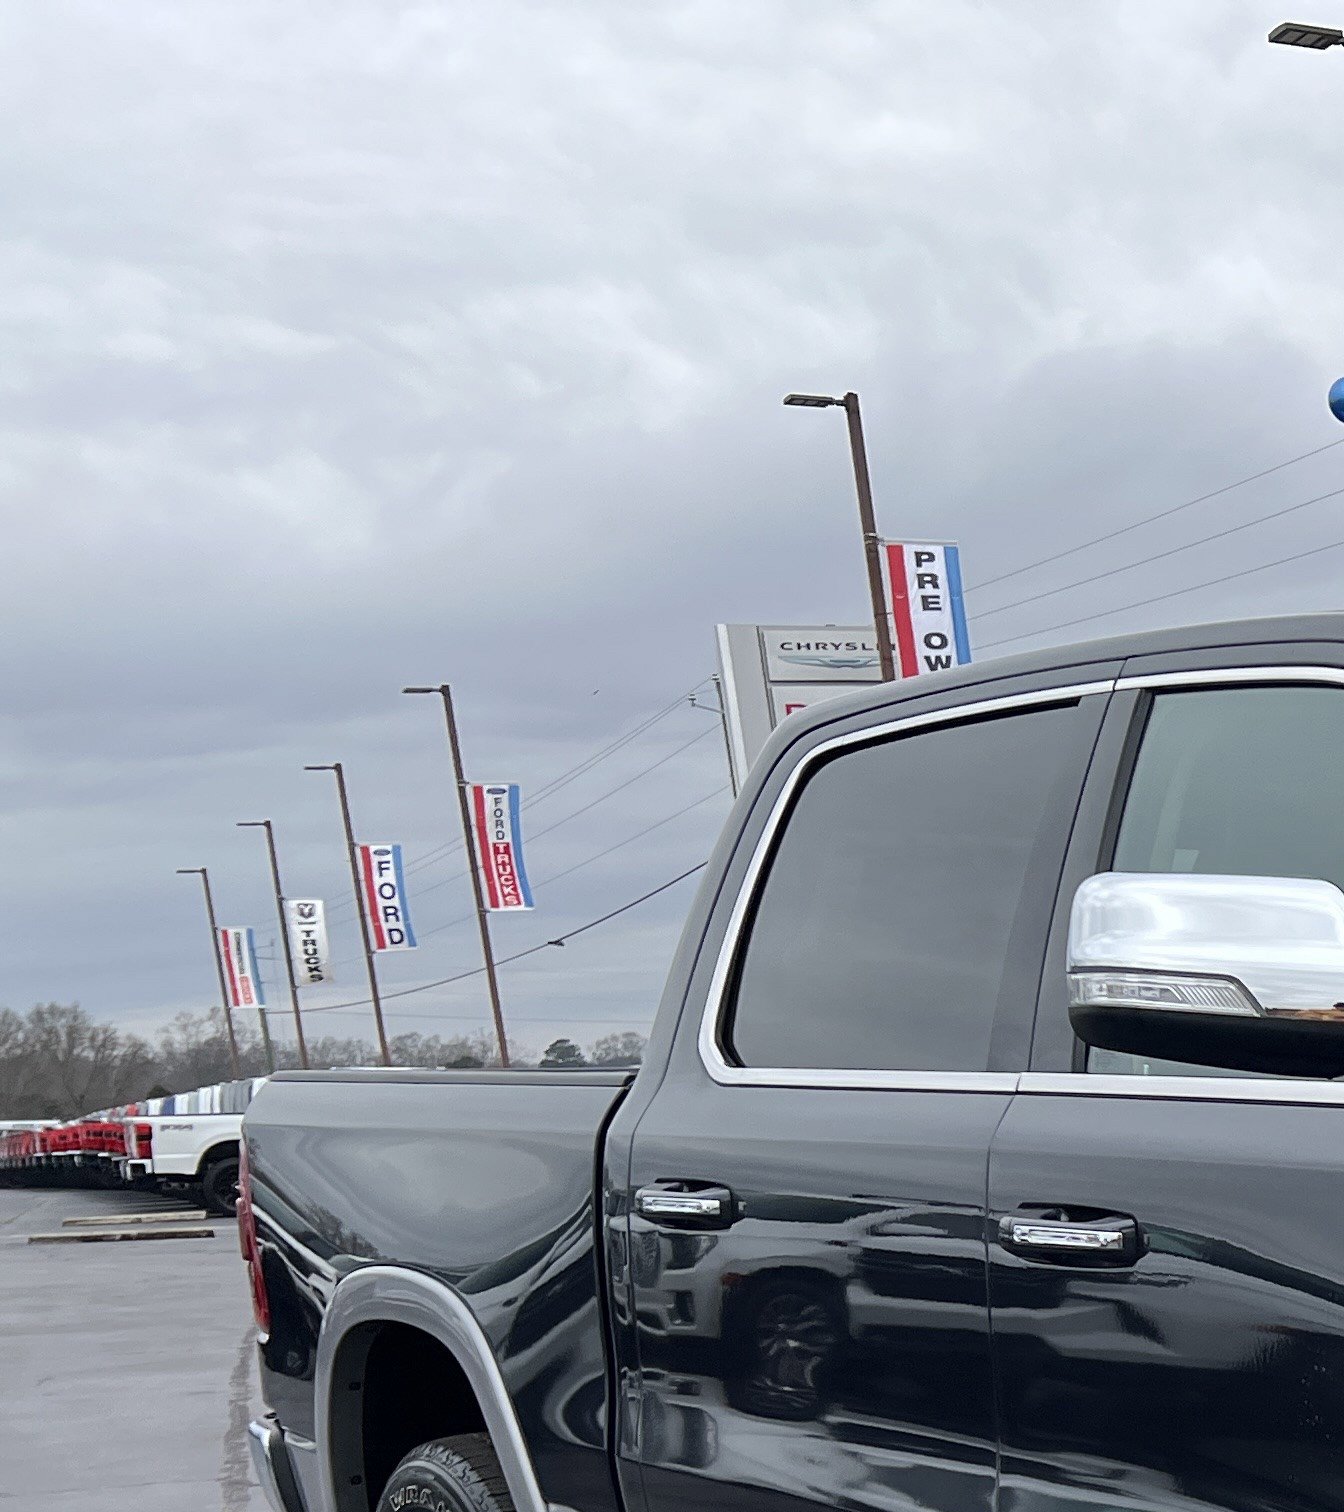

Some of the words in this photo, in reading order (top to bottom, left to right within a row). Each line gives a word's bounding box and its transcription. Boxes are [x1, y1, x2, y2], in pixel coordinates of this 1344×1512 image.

[914, 551, 942, 611] PRE
[780, 642, 896, 651] CHRYSL
[494, 797, 506, 840] FORD
[496, 844, 519, 905] TRUCKS
[378, 861, 404, 945] FORD
[301, 930, 324, 982] TRUCKS
